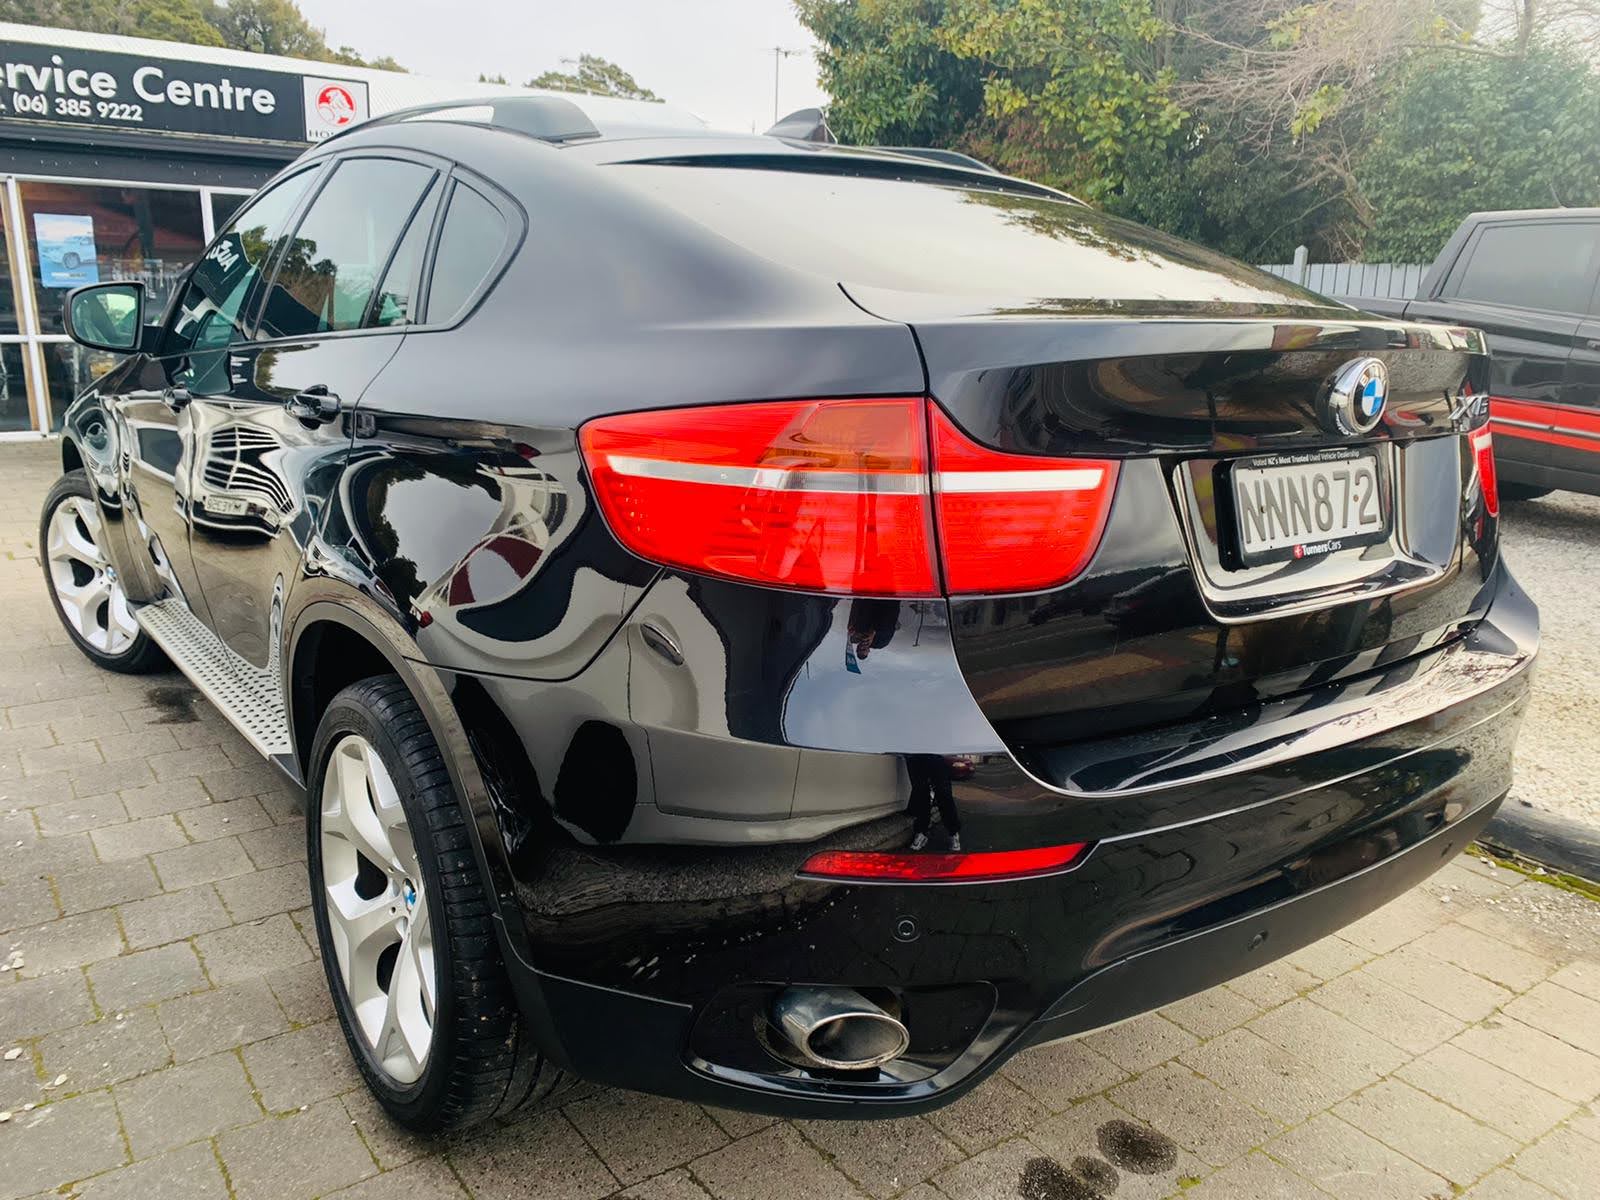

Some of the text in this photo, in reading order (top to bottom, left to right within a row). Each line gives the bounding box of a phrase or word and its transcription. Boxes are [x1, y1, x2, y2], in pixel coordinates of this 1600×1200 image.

[0, 55, 276, 114] rvice Centre
[13, 91, 47, 115] (06)
[55, 97, 92, 117] 385
[97, 101, 143, 121] 9222
[1252, 451, 1360, 466] Voted NZ's Most Trusted Used Vehicle Dealership
[1238, 468, 1377, 544] NNN872
